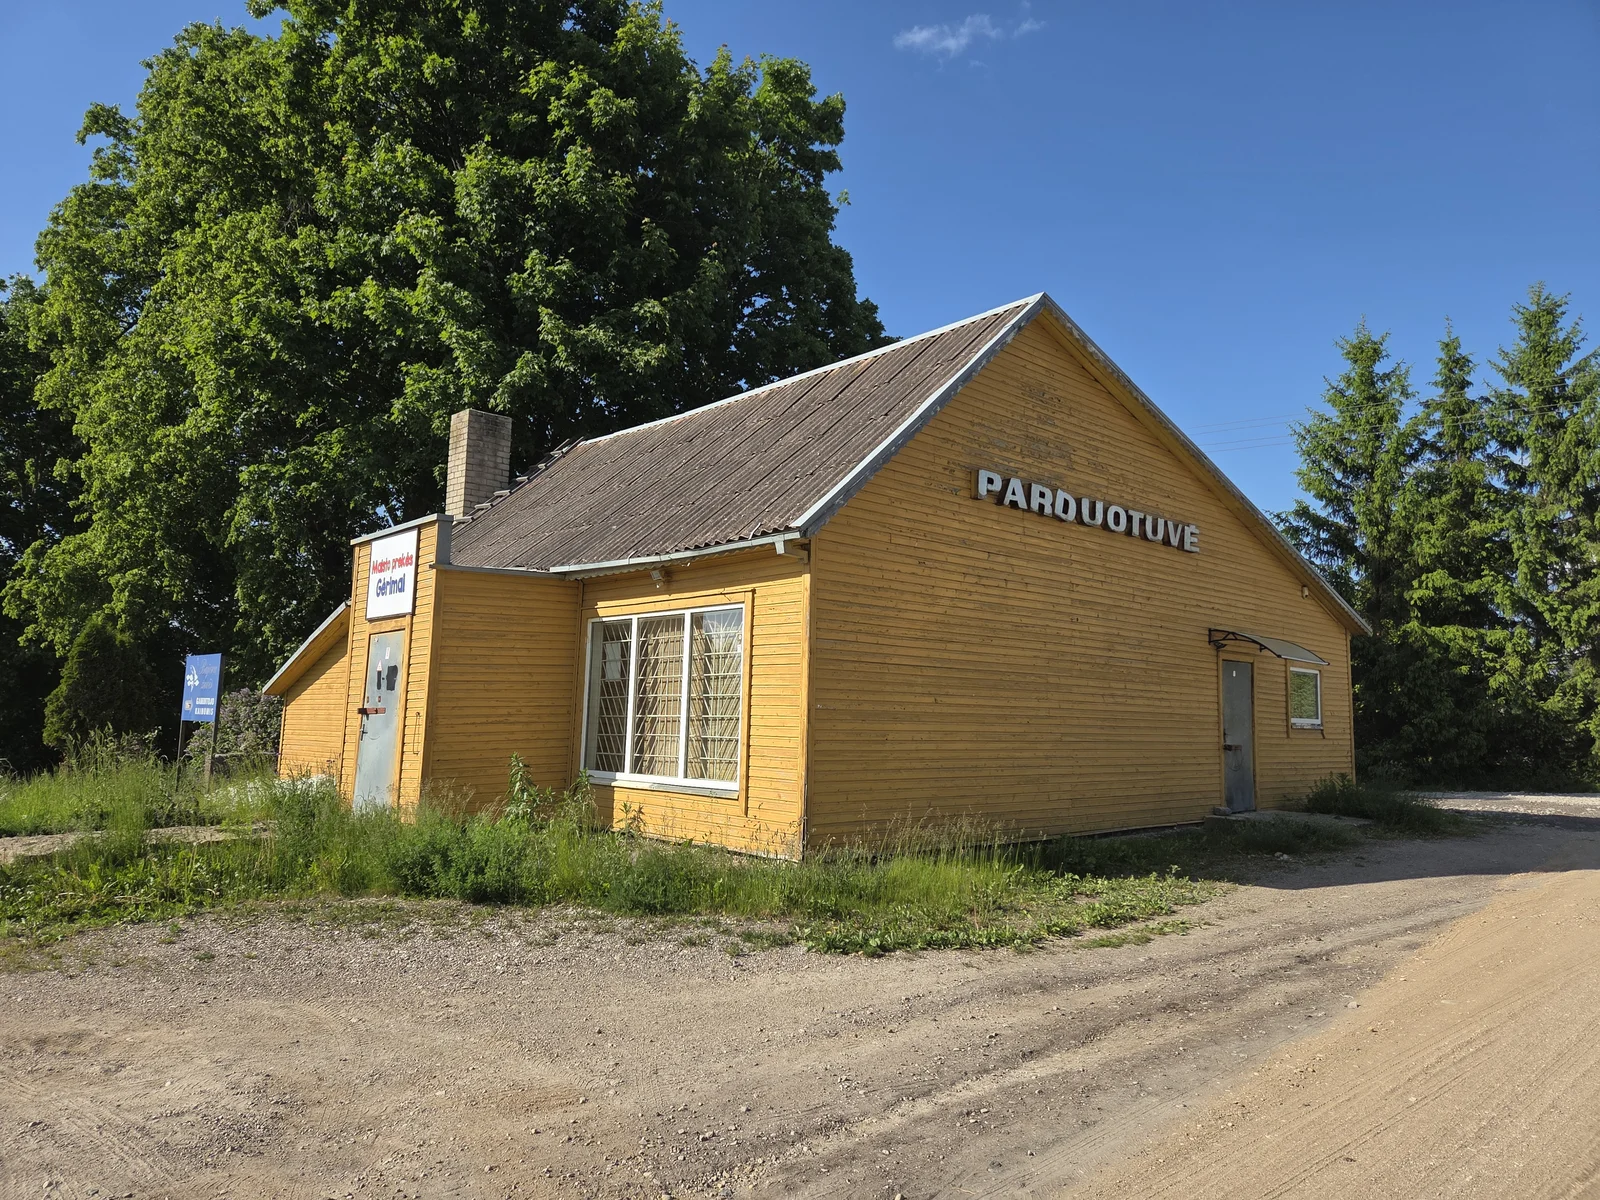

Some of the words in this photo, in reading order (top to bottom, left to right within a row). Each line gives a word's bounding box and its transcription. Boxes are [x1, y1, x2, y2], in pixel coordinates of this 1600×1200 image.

[975, 469, 1200, 553] PARDUOTUVĖ
[372, 557, 391, 575] Maisto
[391, 552, 413, 573] prekės
[376, 573, 405, 598] Gėrimai
